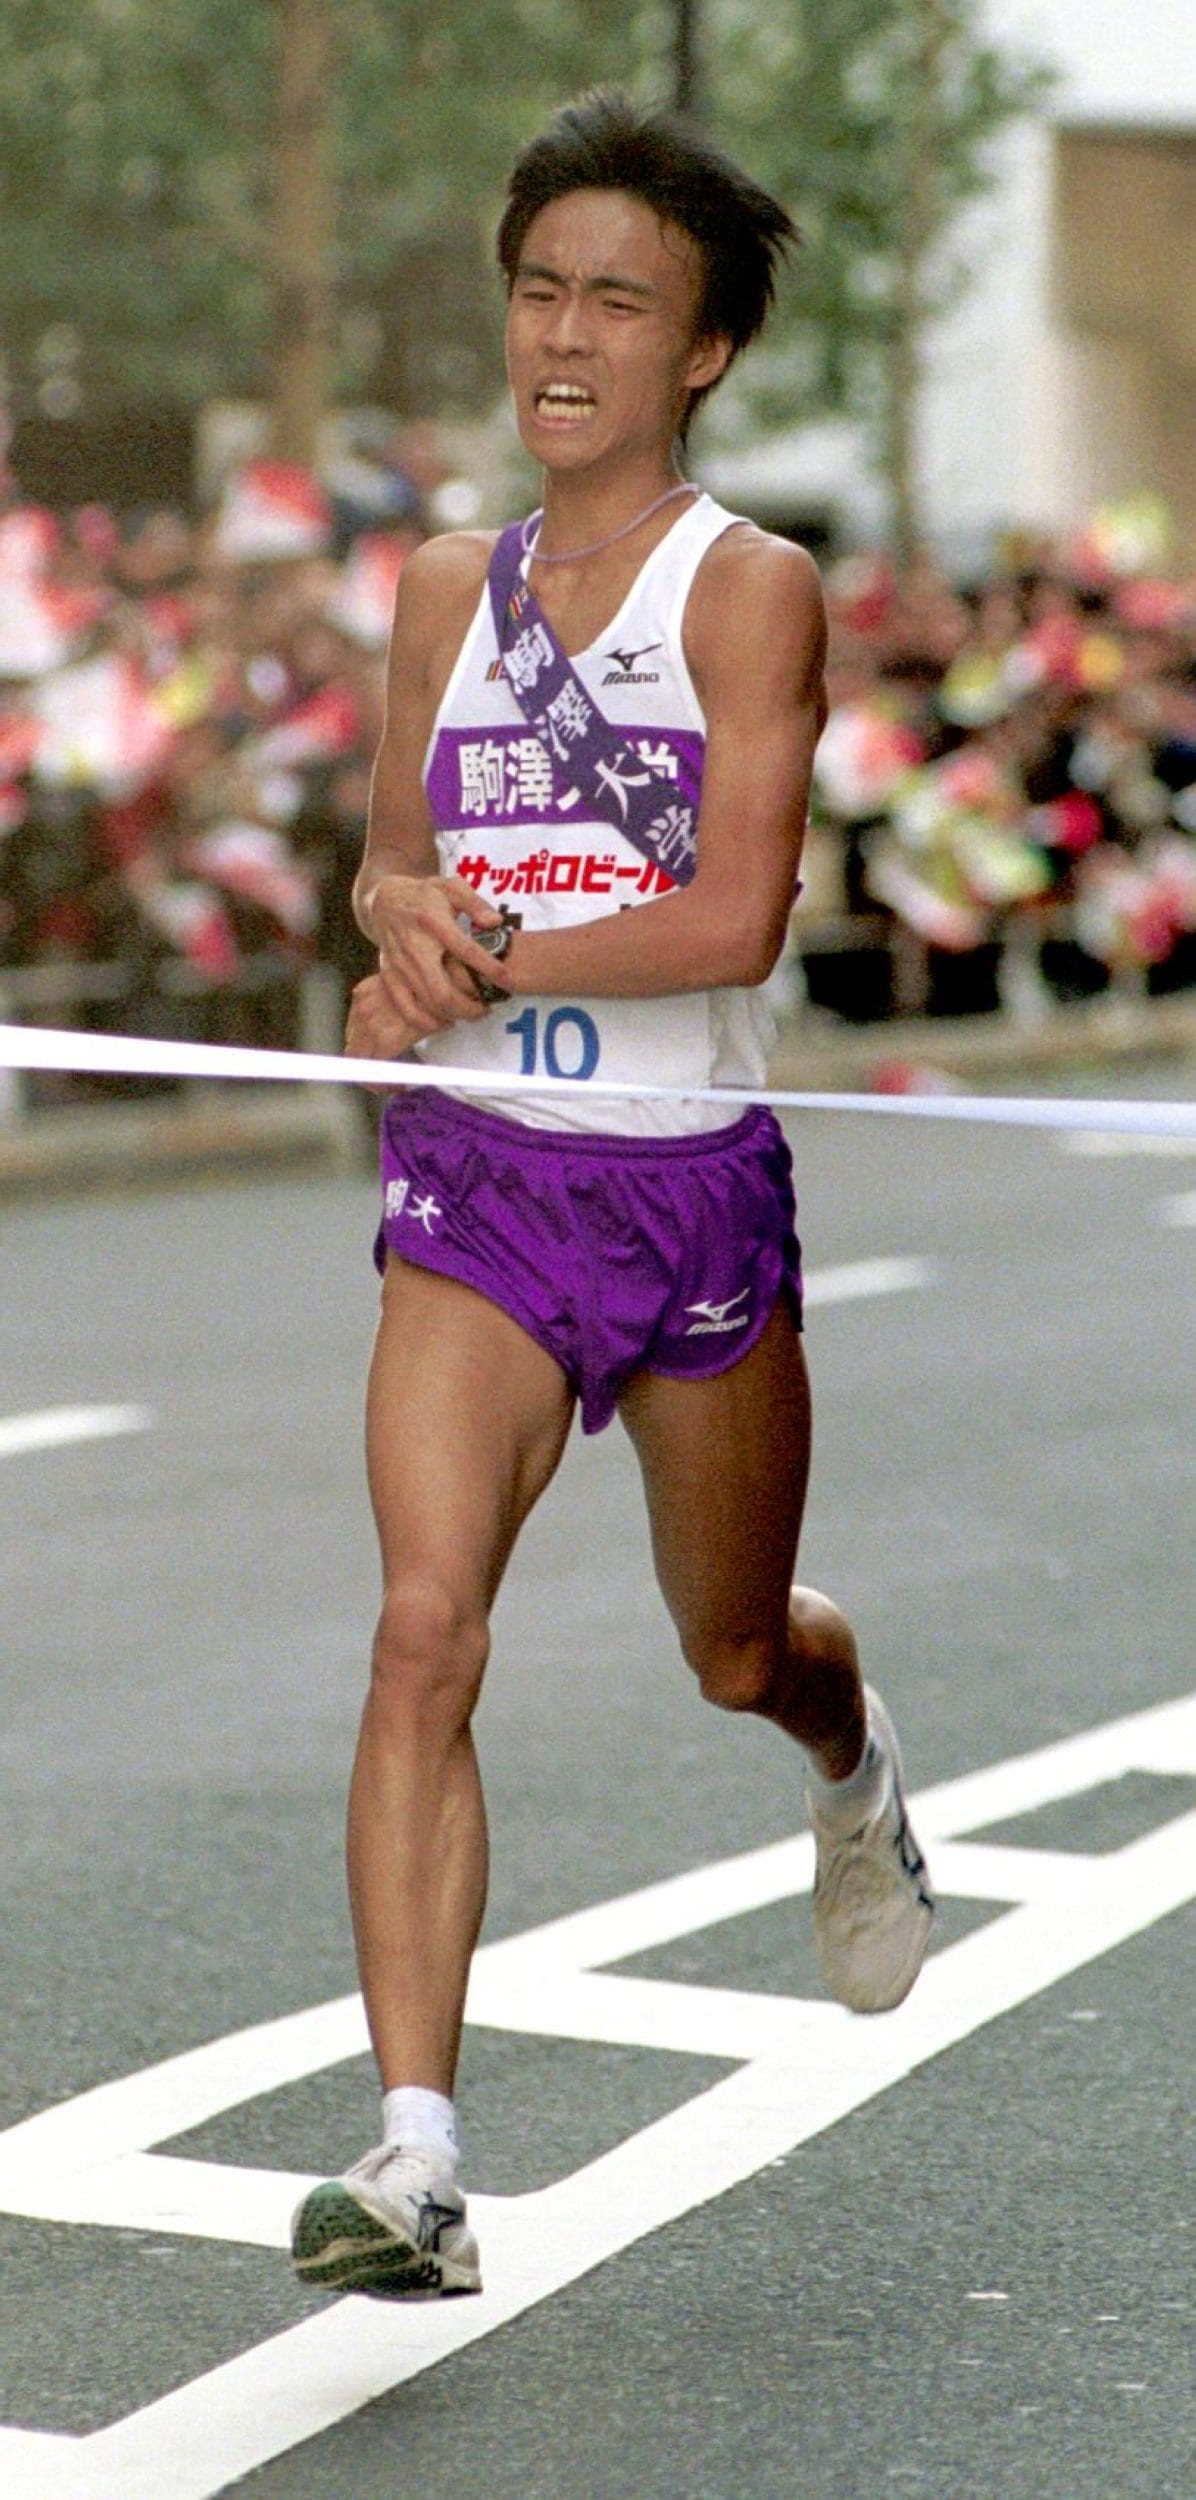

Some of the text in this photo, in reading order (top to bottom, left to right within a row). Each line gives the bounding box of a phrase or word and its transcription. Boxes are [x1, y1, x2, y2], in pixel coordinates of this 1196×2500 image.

[456, 849, 678, 895] サッポロビール
[506, 1007, 600, 1081] 10
